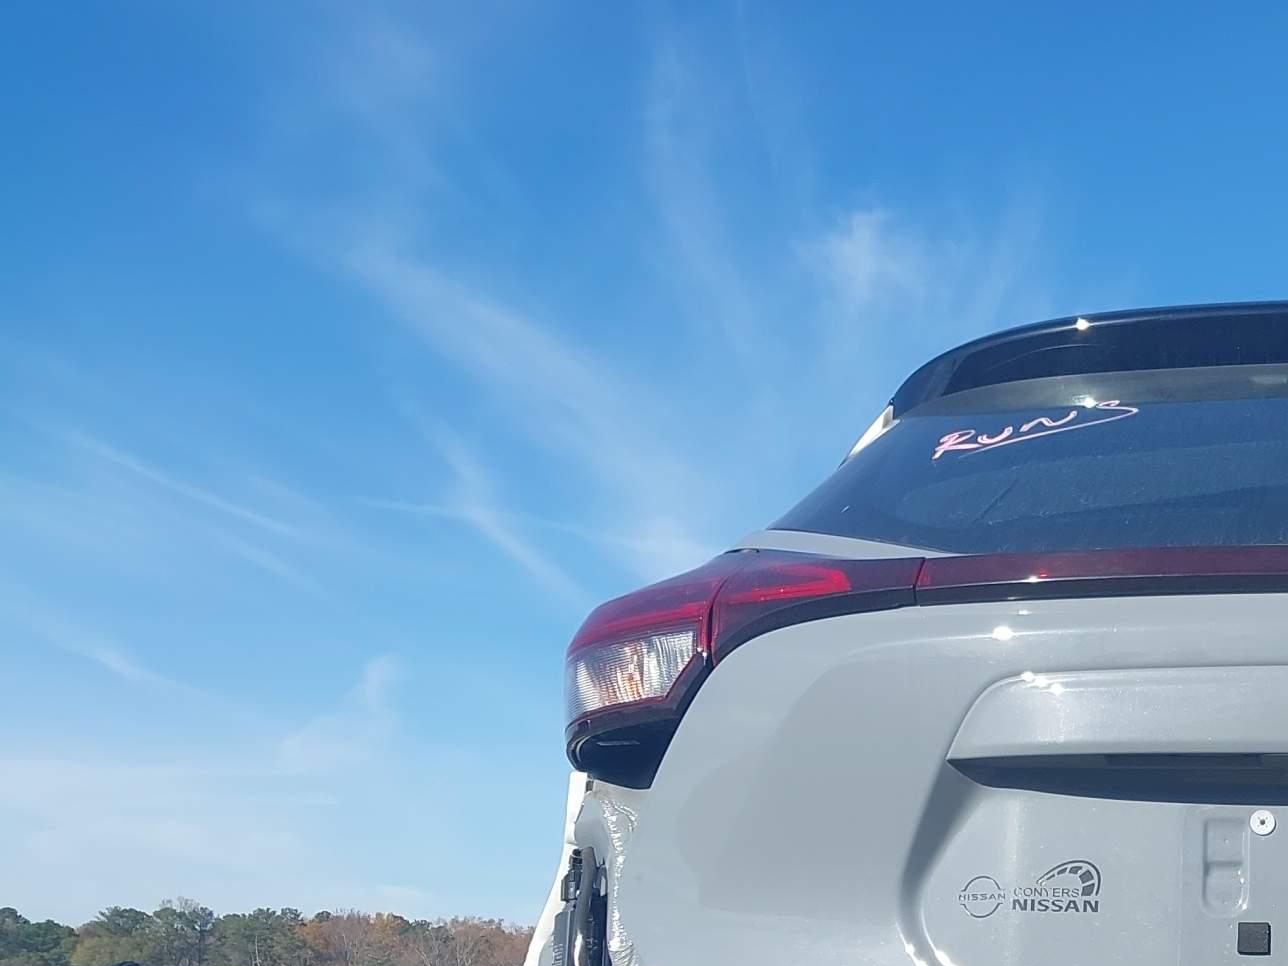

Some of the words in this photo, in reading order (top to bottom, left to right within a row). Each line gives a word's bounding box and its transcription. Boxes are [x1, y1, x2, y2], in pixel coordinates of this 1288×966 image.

[931, 399, 1140, 460] RUNS
[957, 892, 1006, 902] NISSAN
[1012, 898, 1100, 913] NISSAN
